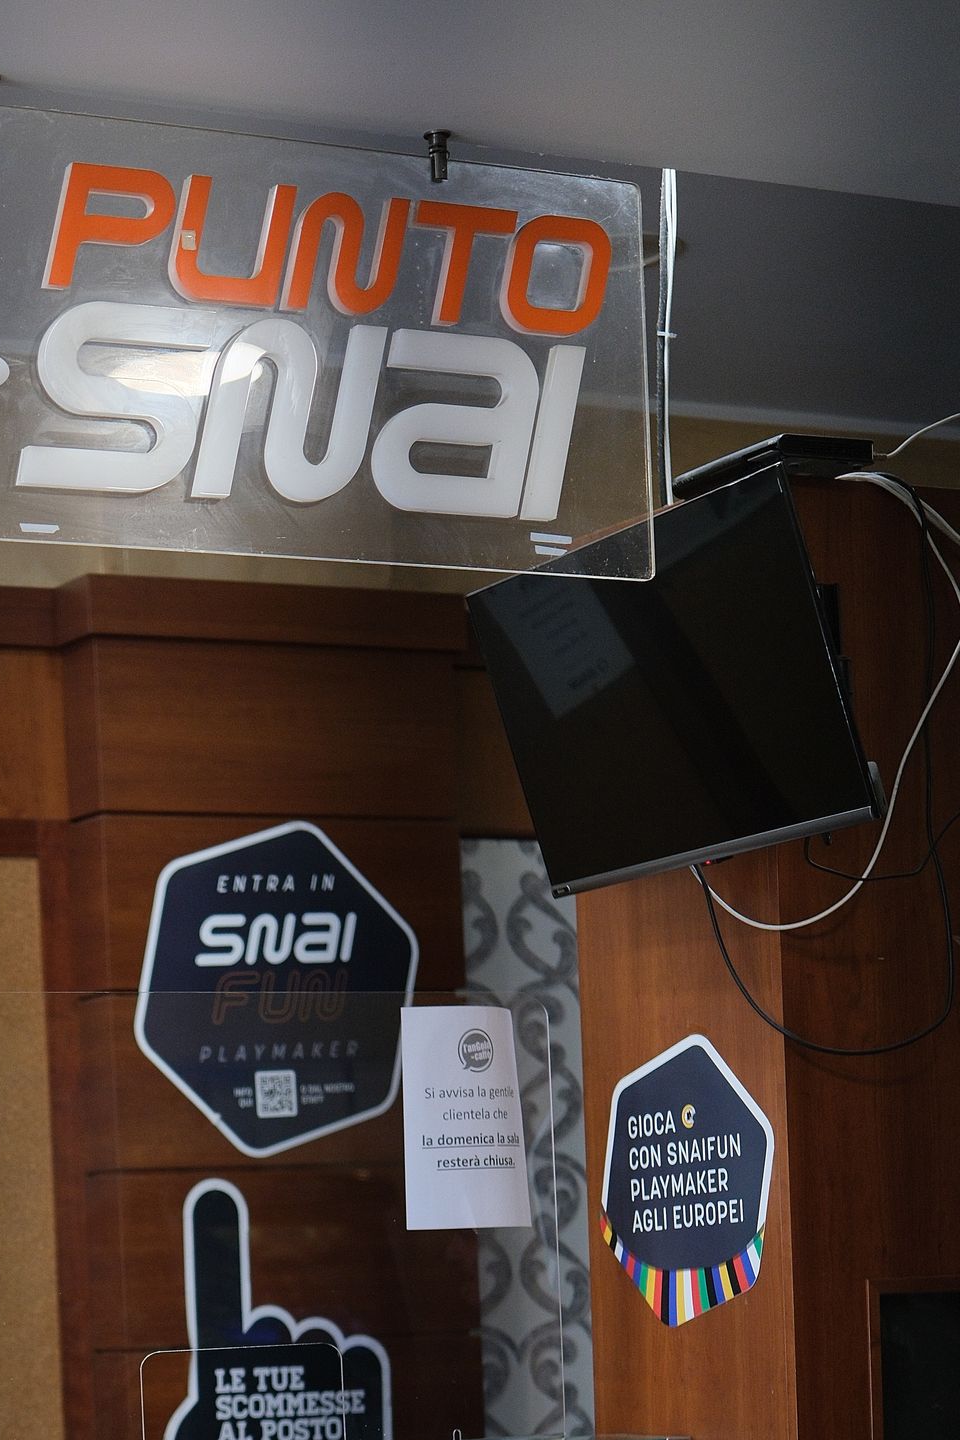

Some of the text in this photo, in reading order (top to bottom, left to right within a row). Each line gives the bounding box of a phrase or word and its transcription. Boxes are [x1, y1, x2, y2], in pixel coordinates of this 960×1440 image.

[42, 161, 612, 337] PUNTO
[216, 873, 335, 894] ENTRA IN
[211, 968, 349, 1025] FUN
[198, 1039, 360, 1063] PLAYMAKER
[424, 1085, 515, 1100] Si avvisa la gentile
[442, 1108, 508, 1121] clientela che
[627, 1110, 677, 1139] GIOCA
[422, 1132, 520, 1147] la domenica la sala
[628, 1132, 742, 1171] CON SNAIFUN
[437, 1154, 516, 1168] resterà chiusa.
[630, 1167, 729, 1202] PLAYMAKER
[632, 1197, 745, 1234] AGLI EUROPEI
[214, 1365, 305, 1394] LE TUE
[215, 1389, 365, 1420] SCOMMESSE
